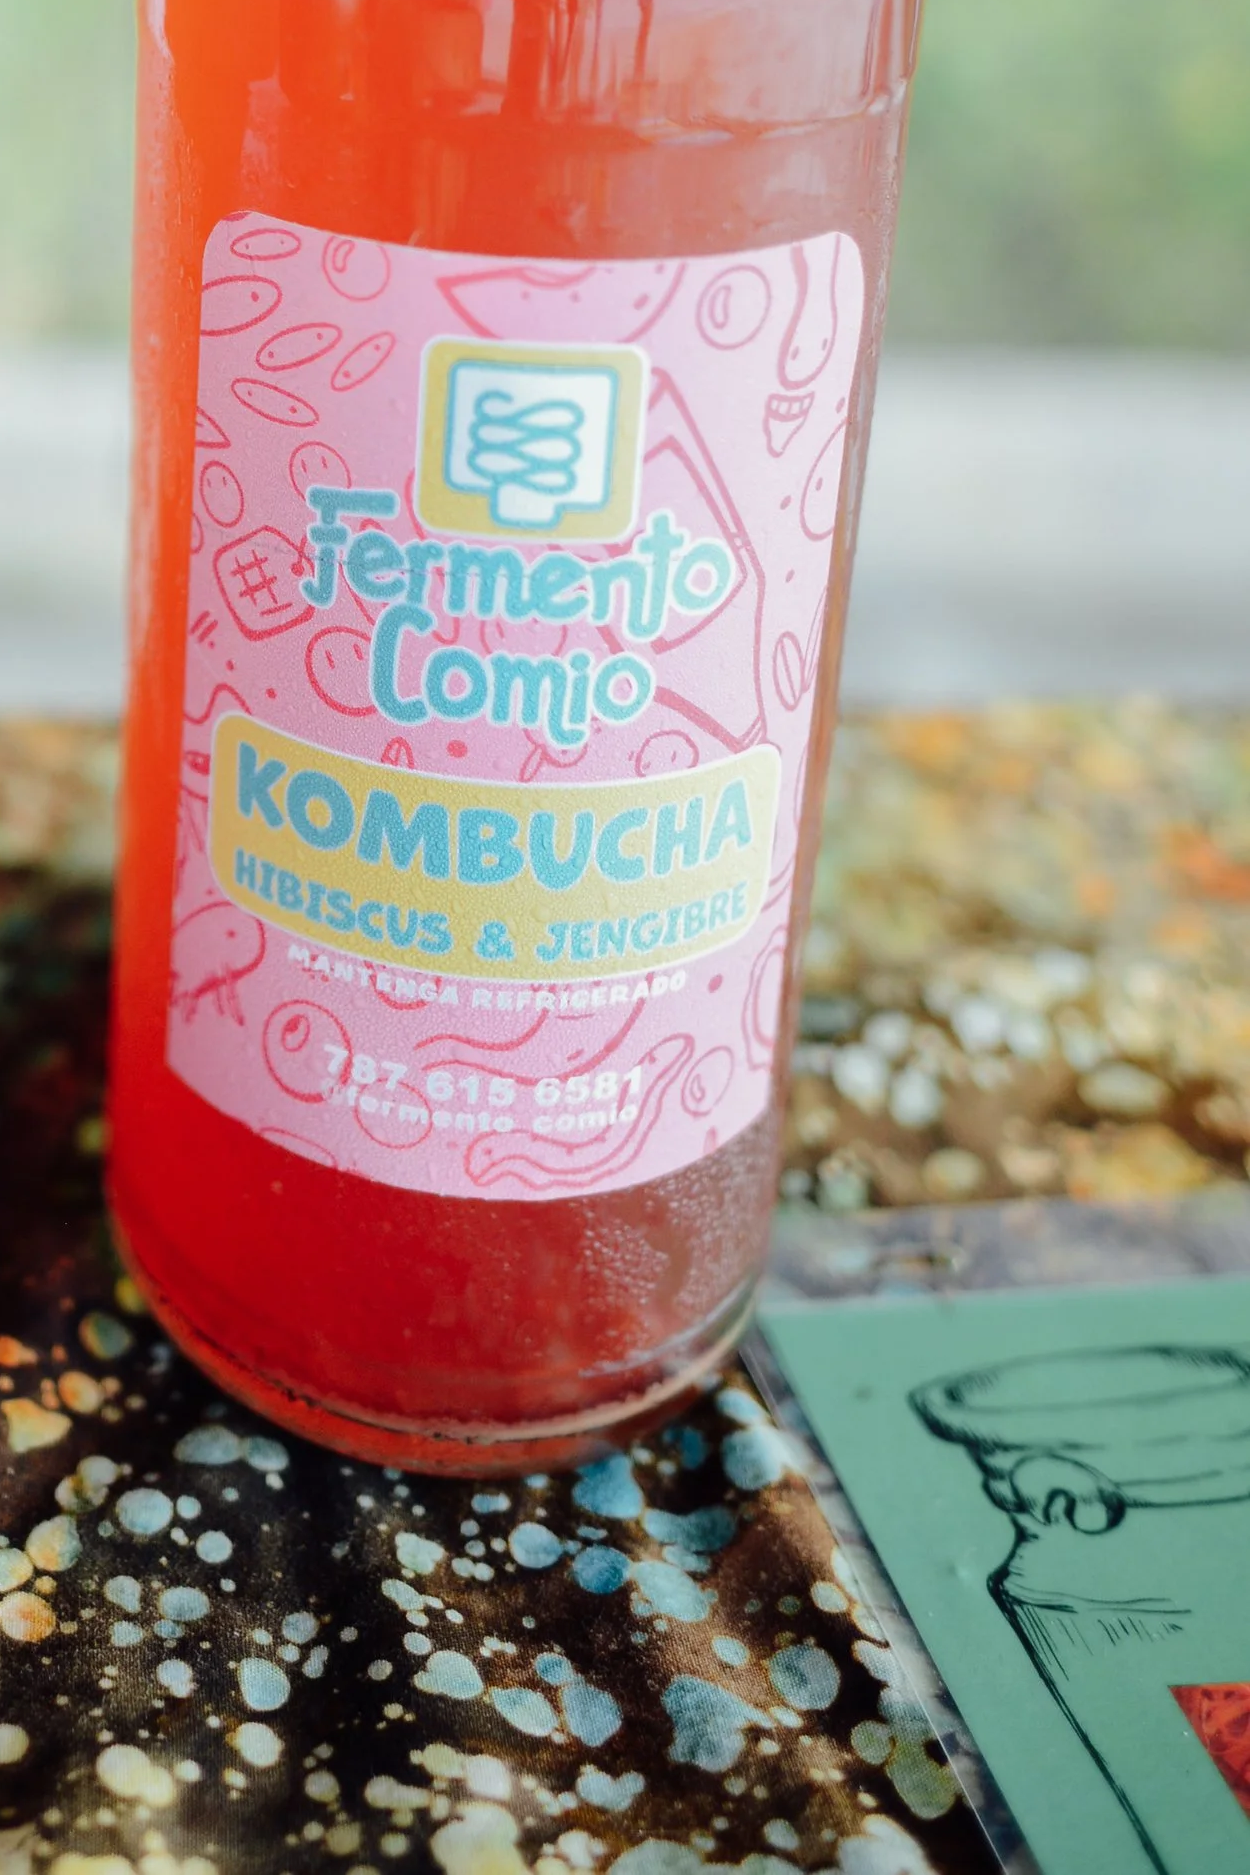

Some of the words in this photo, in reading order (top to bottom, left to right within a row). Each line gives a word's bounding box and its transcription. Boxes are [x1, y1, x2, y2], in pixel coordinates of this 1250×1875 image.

[302, 486, 732, 638] Fermento
[370, 603, 653, 744] Comio
[237, 743, 751, 891] KOMBUCHA
[234, 848, 454, 955] HIBISCUS
[475, 920, 515, 960] &
[536, 881, 748, 962] JENGIBRE
[287, 944, 459, 1005] MANTENGA
[471, 970, 687, 1012] REFRIGERADO
[323, 1043, 408, 1090] 787
[426, 1070, 516, 1107] 615
[535, 1064, 642, 1108] 6581
[535, 1101, 639, 1134] comio
